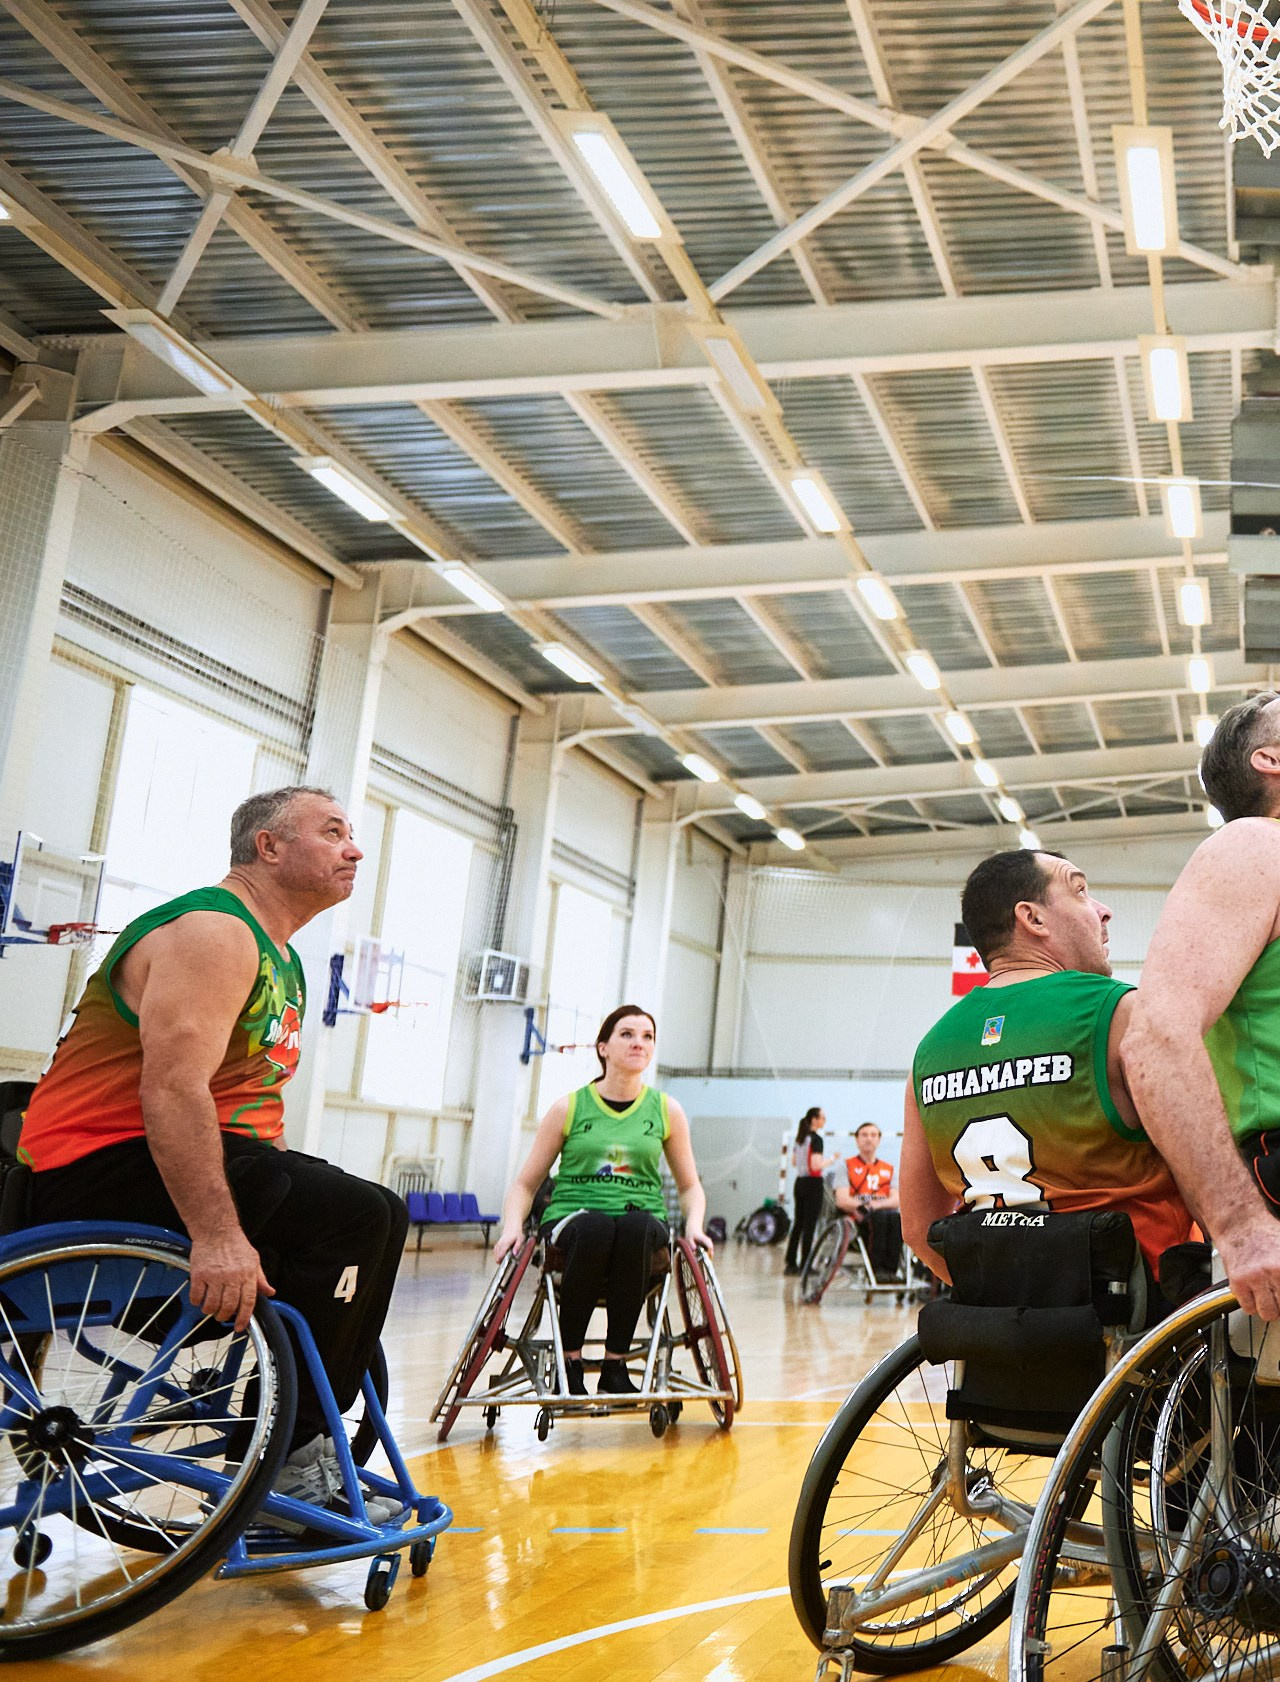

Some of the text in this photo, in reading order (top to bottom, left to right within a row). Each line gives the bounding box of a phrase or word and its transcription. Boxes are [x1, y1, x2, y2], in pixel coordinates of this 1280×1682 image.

[921, 1053, 1074, 1107] ПОНАМАРЕВ
[643, 1120, 654, 1137] 2
[333, 1265, 359, 1304] 4
